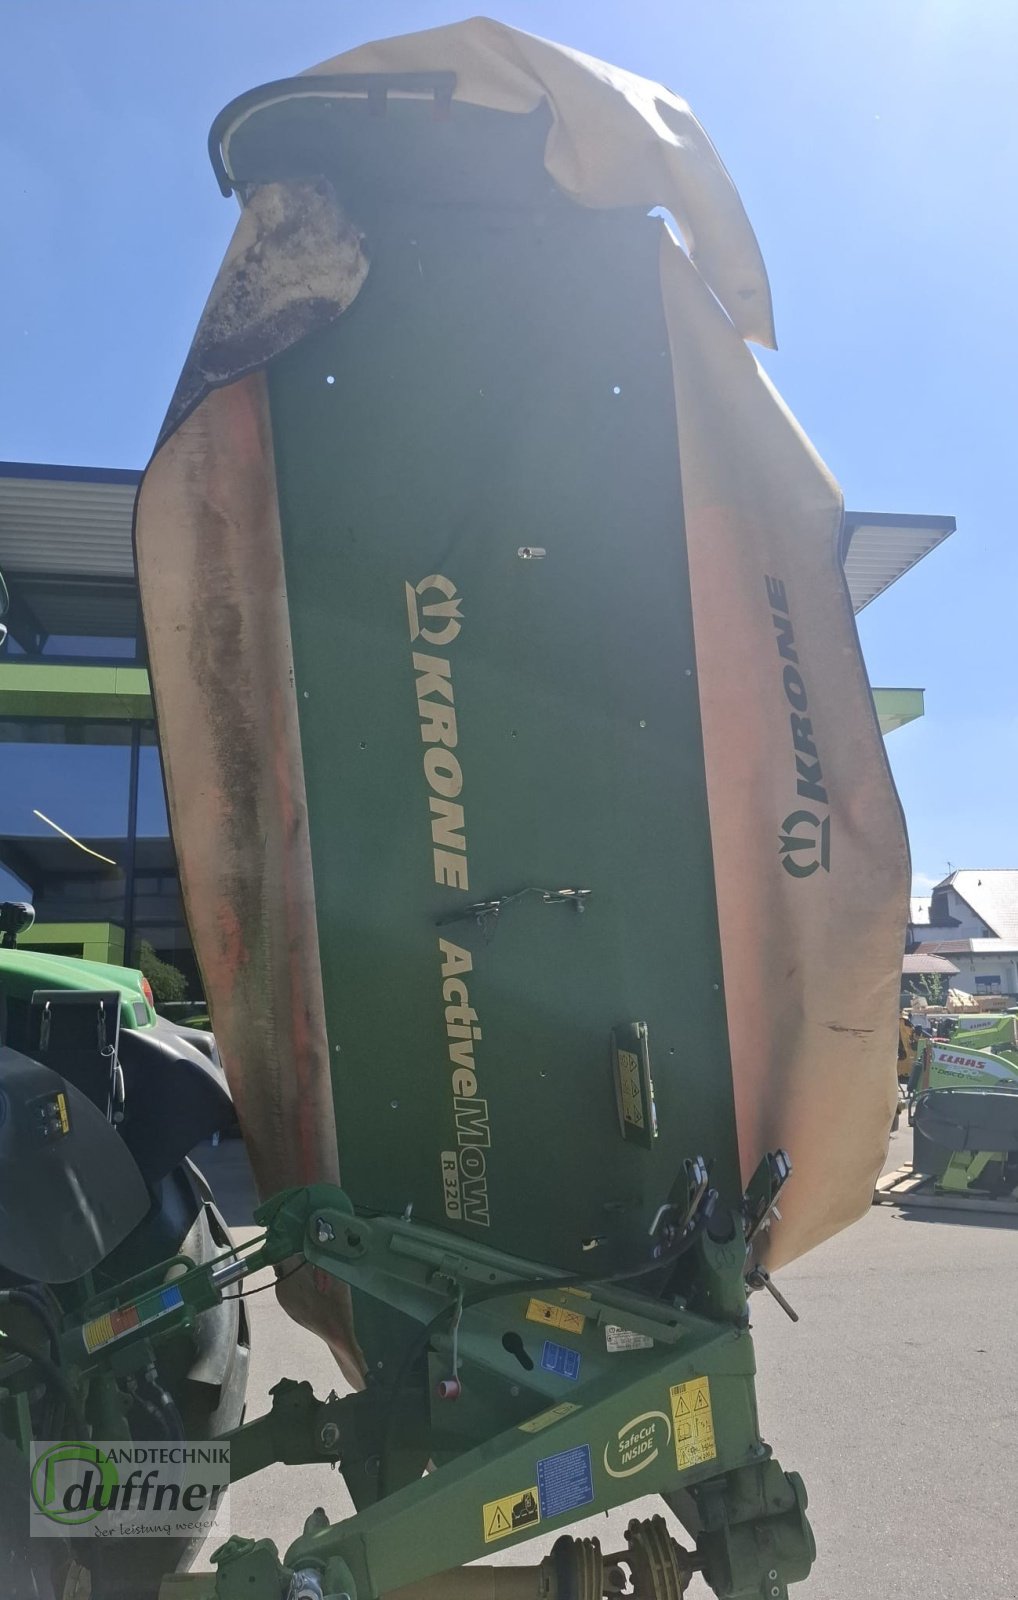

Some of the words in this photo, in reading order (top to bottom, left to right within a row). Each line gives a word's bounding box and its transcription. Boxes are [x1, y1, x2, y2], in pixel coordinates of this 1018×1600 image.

[764, 574, 829, 804] KRONE
[412, 651, 469, 890] KRONE
[443, 1160, 456, 1170] R
[445, 1178, 459, 1211] 320
[618, 1423, 655, 1453] SafeCut
[622, 1437, 653, 1465] INSIDE
